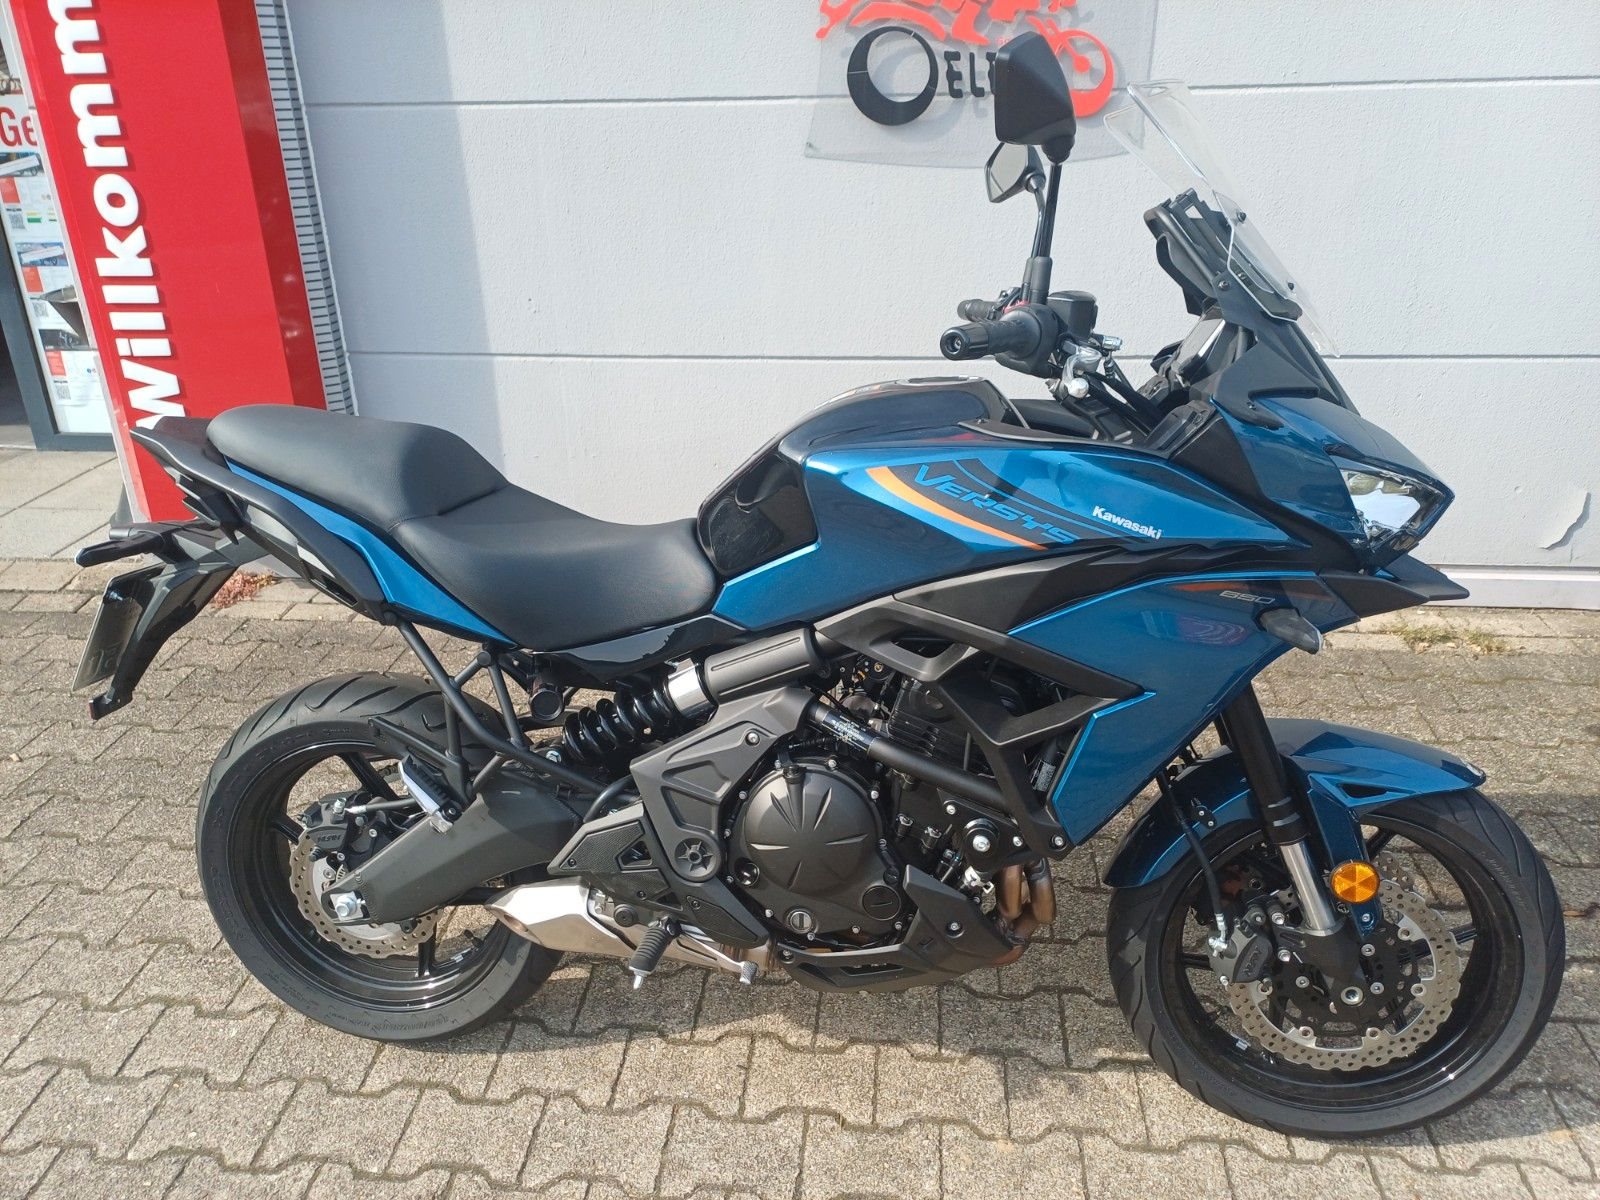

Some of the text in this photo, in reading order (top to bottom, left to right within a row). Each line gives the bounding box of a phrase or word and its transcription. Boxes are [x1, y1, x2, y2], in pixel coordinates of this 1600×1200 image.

[914, 464, 1081, 545] VERSYS
[1092, 505, 1162, 540] Kawasaki
[1219, 590, 1275, 605] 650
